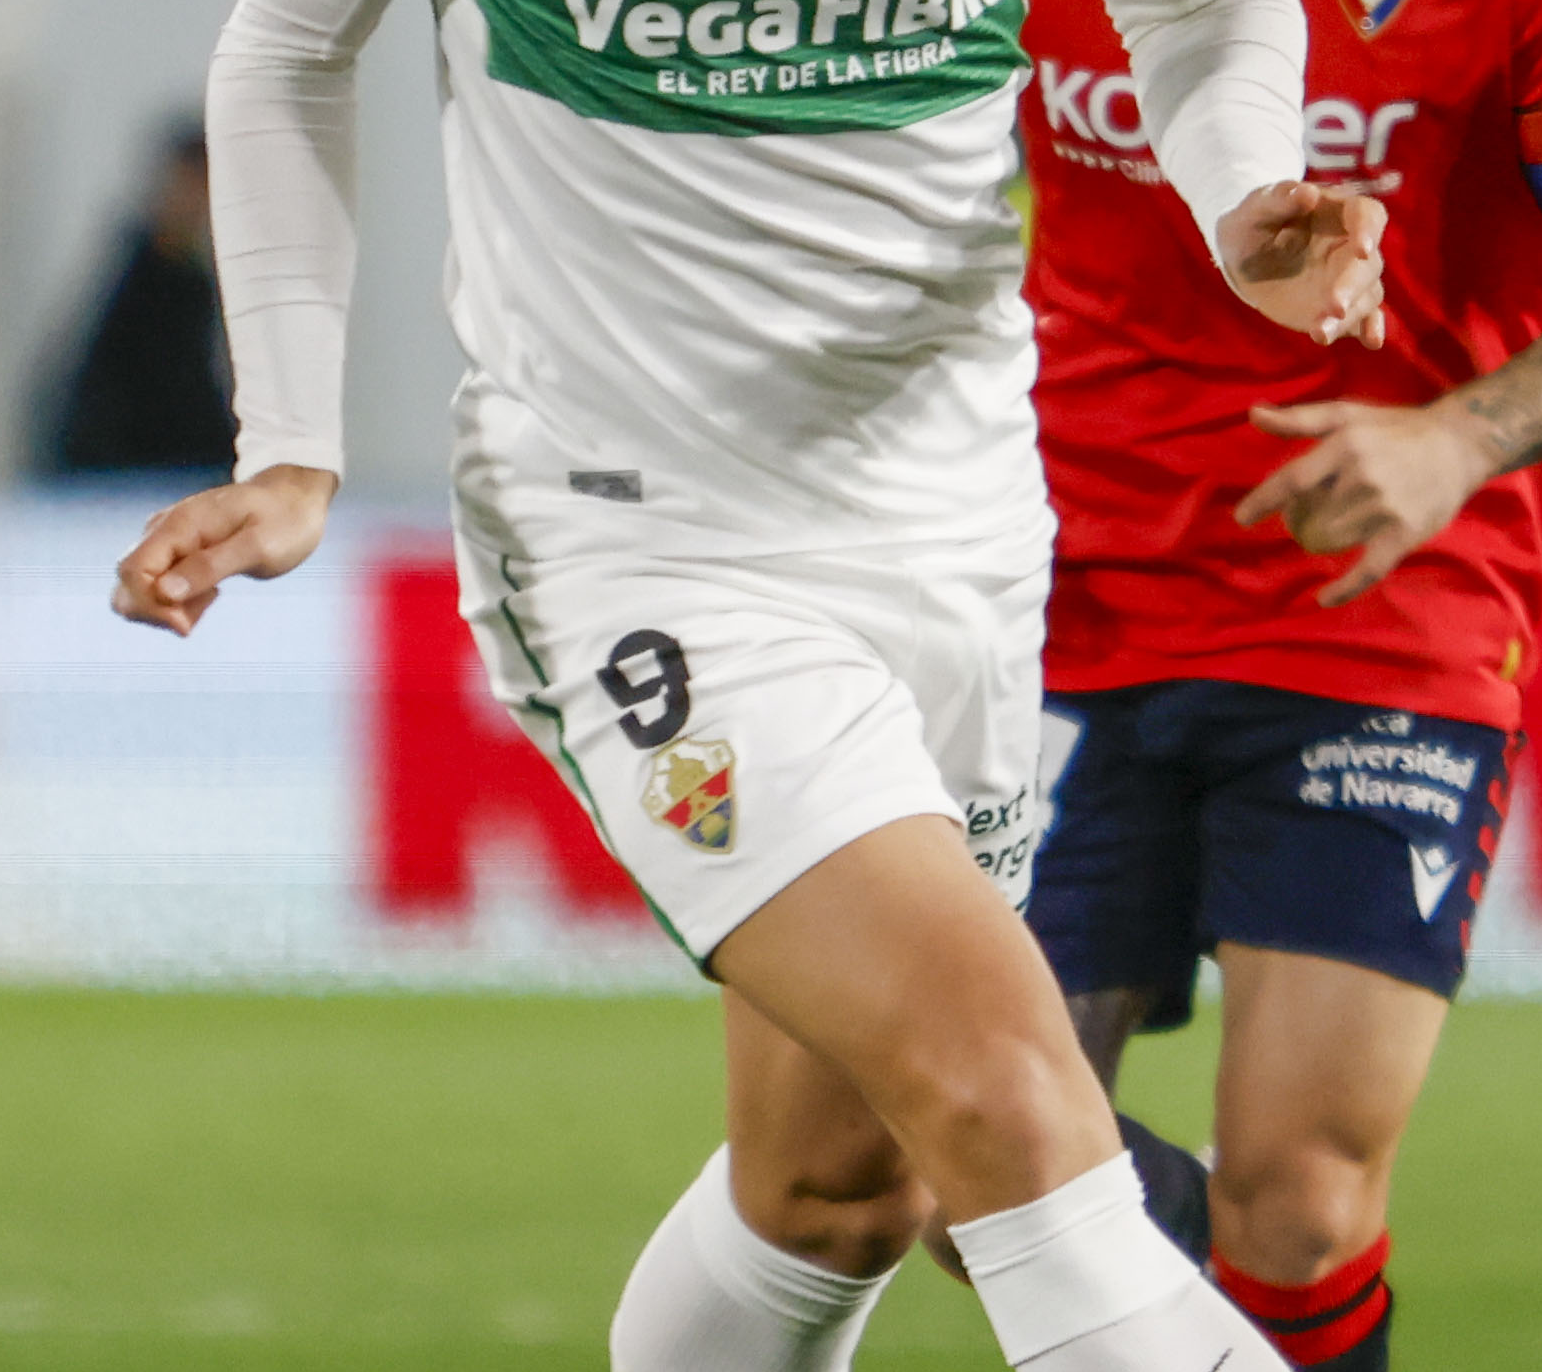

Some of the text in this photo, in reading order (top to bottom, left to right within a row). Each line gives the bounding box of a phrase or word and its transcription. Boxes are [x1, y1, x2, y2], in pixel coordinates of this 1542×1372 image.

[658, 37, 957, 96] EL REY DE LA FIBRA
[1036, 59, 1419, 174] koer
[596, 628, 693, 749] 9
[966, 785, 1027, 836] ext
[1341, 771, 1460, 825] Navarra
